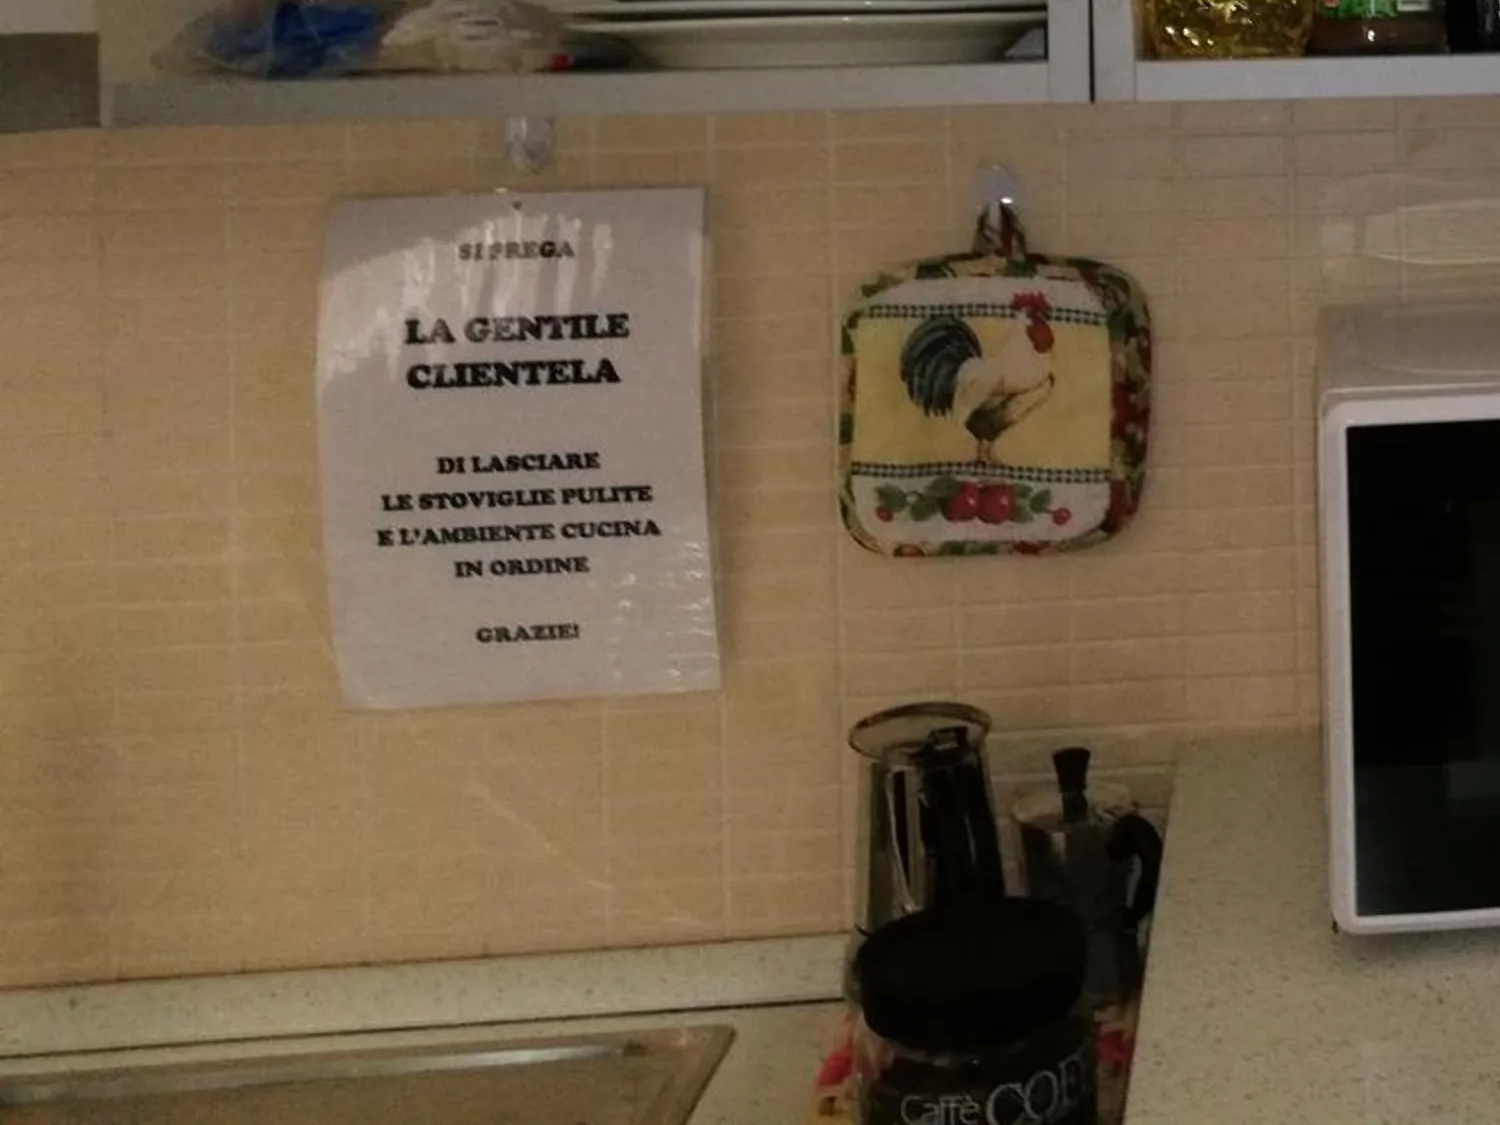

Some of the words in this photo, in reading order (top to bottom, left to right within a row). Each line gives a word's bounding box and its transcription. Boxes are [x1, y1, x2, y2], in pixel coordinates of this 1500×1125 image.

[459, 242, 484, 261] SI
[489, 240, 576, 260] PREGA
[404, 318, 456, 345] LA
[464, 313, 631, 343] GENTILE
[406, 357, 621, 389] CLIENTELA
[437, 456, 466, 475] DI
[471, 452, 600, 473] LASCIARE
[381, 493, 413, 511] LE
[418, 490, 556, 511] STOVIGLIE
[561, 485, 653, 505] PULITE
[377, 529, 394, 546] E
[401, 524, 556, 546] L'AMBIENTE
[560, 520, 661, 540] CUCINA
[454, 560, 483, 578] IN
[489, 556, 590, 577] ORDINE
[475, 623, 580, 644] GRAZIE!
